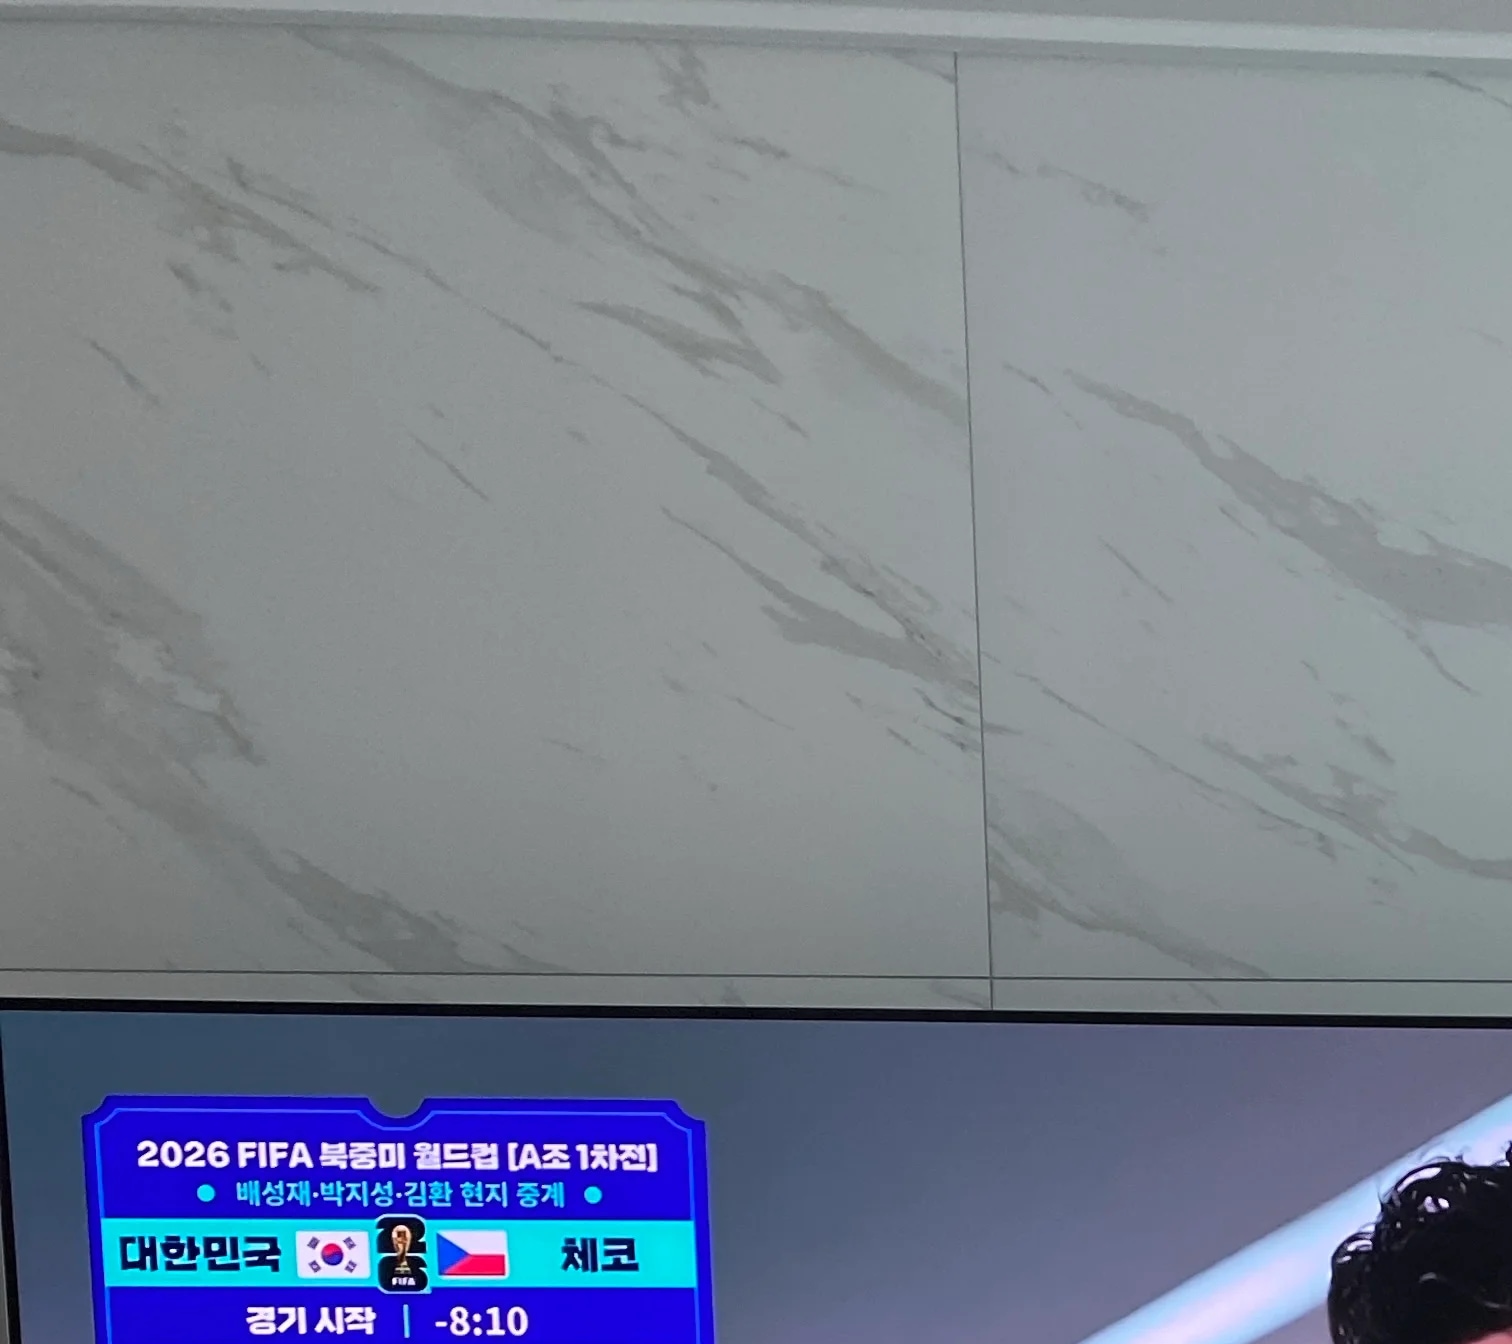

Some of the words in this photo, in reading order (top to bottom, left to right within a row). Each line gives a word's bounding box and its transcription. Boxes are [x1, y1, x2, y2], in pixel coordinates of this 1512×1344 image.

[137, 1140, 230, 1168] 2026
[237, 1142, 314, 1169] FIFA
[319, 1142, 406, 1170] 북중미
[413, 1142, 500, 1171] 월드컵
[507, 1142, 571, 1172] [A조
[575, 1143, 659, 1173] 1차전]
[460, 1181, 508, 1208] 현지
[516, 1181, 566, 1208] 중계
[119, 1235, 282, 1273] 대한민국
[561, 1237, 639, 1273] 체코
[391, 1276, 416, 1286] FIFA
[246, 1307, 307, 1335] 경기
[314, 1307, 377, 1335] 시작
[435, 1306, 529, 1337] -8:10
